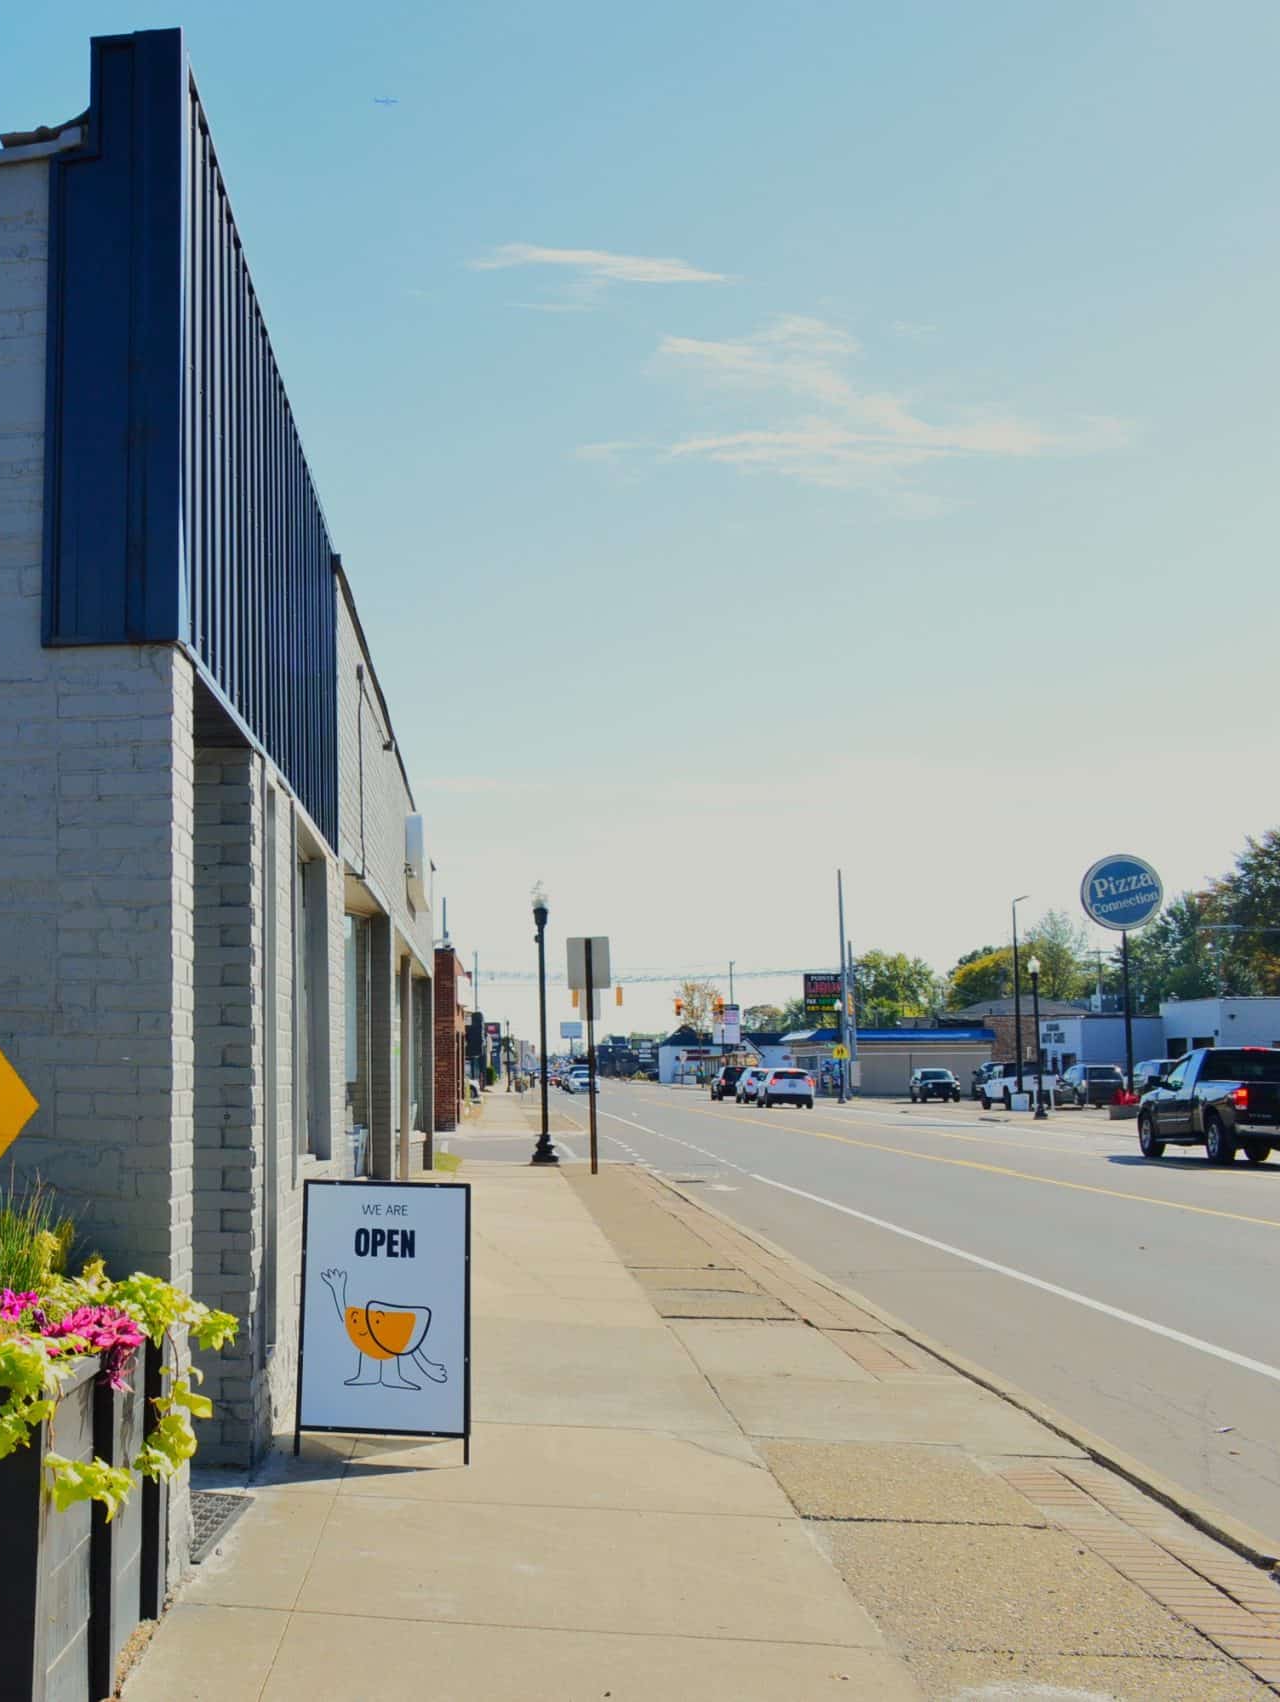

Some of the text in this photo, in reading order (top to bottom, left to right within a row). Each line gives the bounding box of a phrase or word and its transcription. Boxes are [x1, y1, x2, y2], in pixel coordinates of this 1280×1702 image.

[1092, 873, 1154, 898] Pizza
[1092, 892, 1158, 914] Connection
[361, 1204, 409, 1217] WE ARE
[354, 1228, 416, 1258] OPEN
